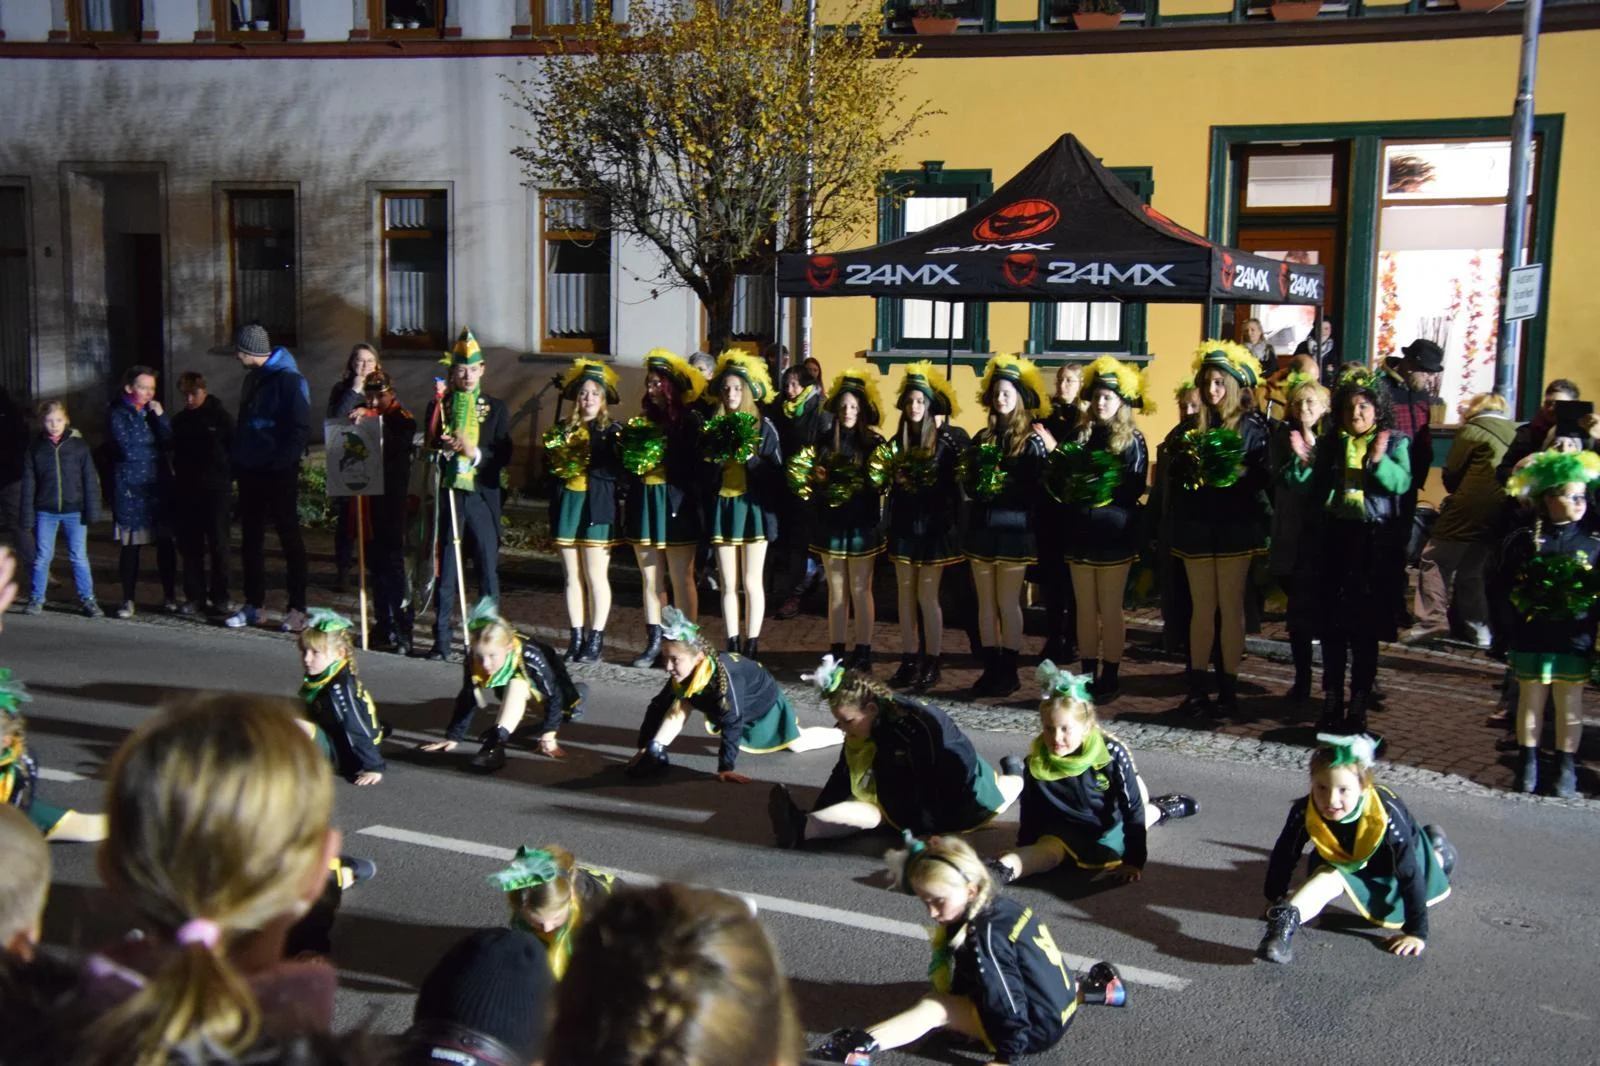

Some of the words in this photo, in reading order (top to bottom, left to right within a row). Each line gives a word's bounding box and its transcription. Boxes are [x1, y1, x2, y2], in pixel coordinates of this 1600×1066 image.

[845, 264, 960, 285] 24MX
[1047, 262, 1176, 287] 24MX
[1234, 265, 1270, 292] 24MX
[1289, 273, 1319, 299] 24MX
